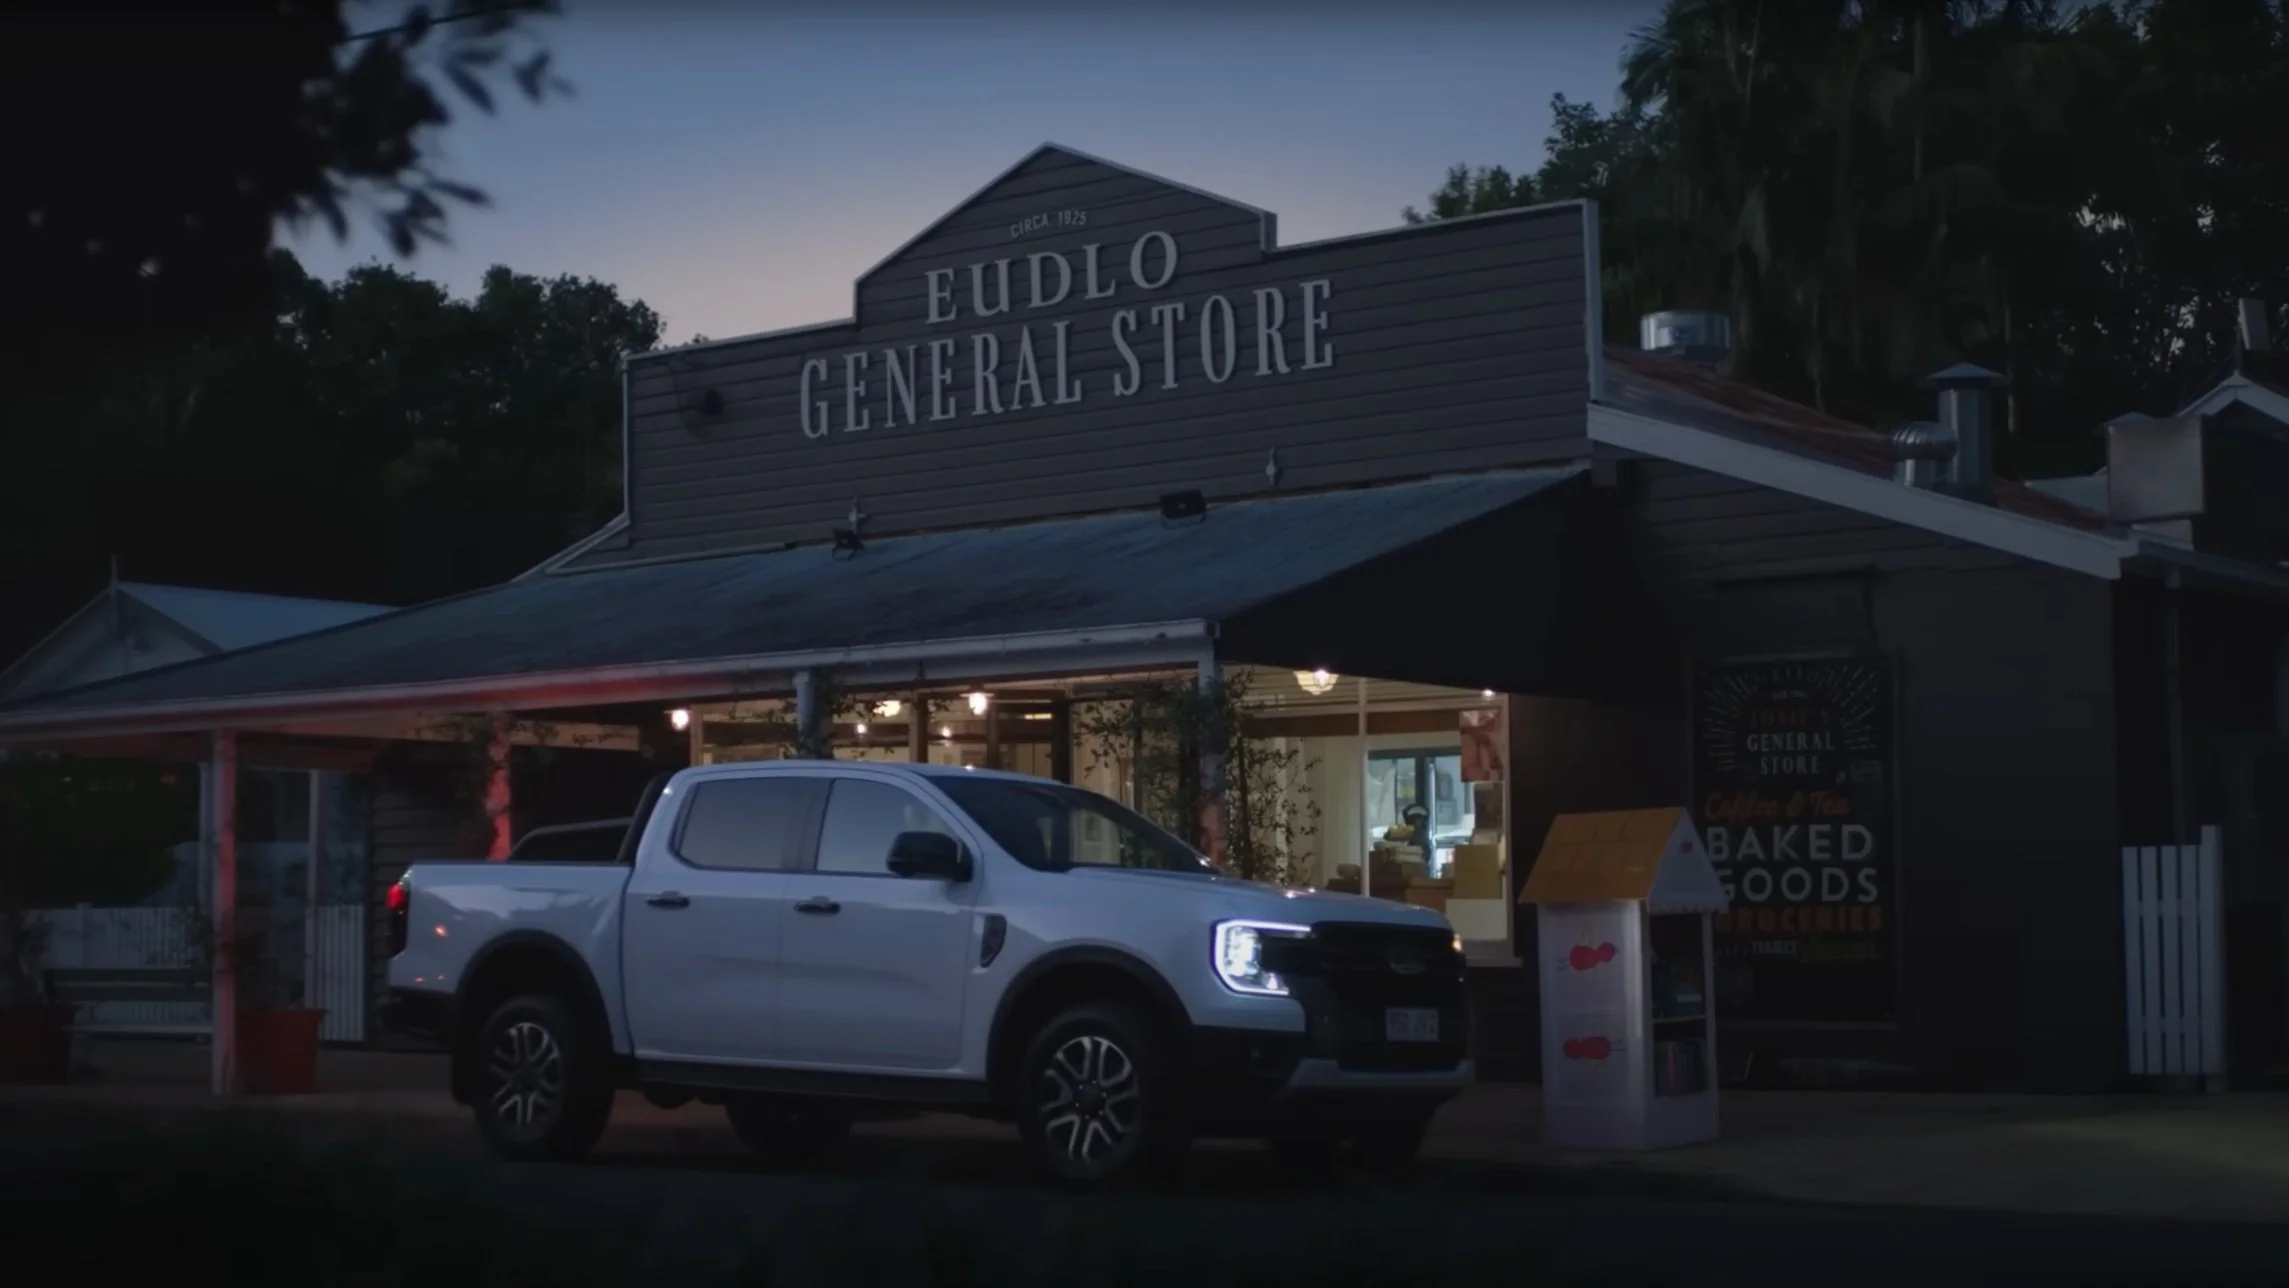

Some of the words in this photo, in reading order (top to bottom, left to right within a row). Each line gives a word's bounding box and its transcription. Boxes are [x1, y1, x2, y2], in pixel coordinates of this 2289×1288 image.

[1010, 213, 1048, 238] CIRCA
[1058, 210, 1087, 226] 1925
[925, 231, 1178, 324] EUDLO
[800, 320, 1082, 438] GENERAL
[1112, 279, 1334, 396] STORE
[1746, 731, 1835, 752] GENERAL
[1759, 756, 1820, 775] STORE
[1706, 824, 1875, 861] BAKED
